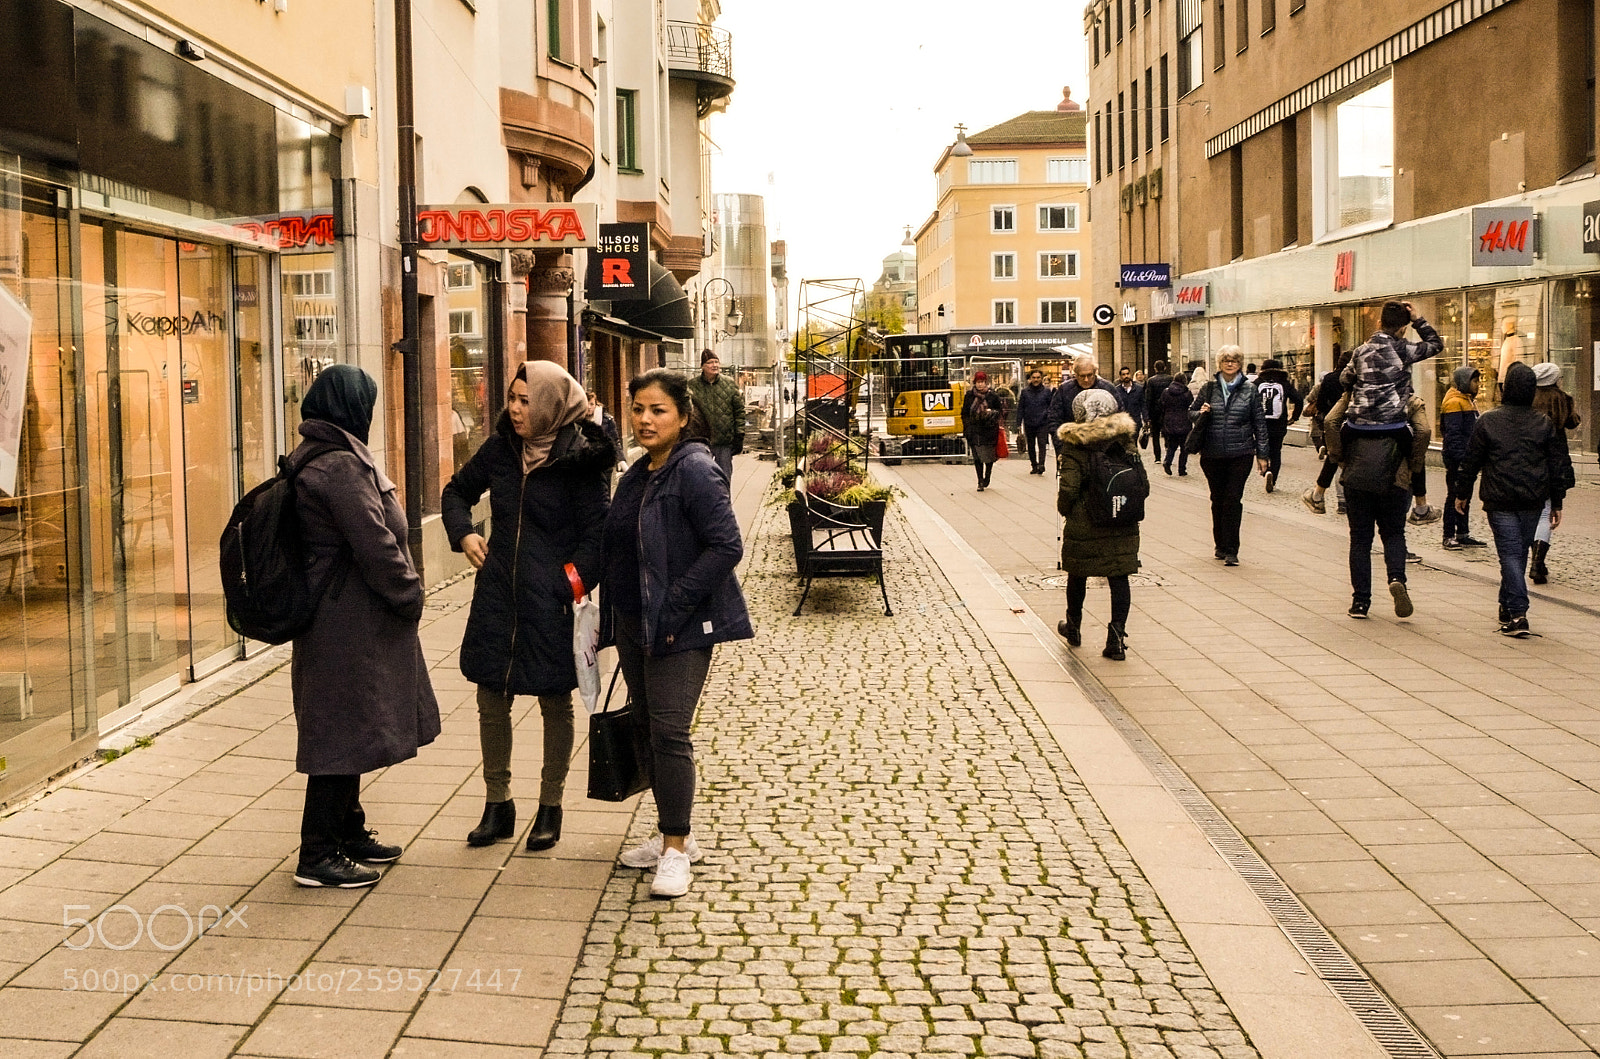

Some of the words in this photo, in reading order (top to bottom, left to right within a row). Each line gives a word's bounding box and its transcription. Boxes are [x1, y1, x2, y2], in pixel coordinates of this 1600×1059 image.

[418, 209, 585, 242] INDISKA
[598, 235, 639, 245] NILSON
[1480, 219, 1529, 253] H&M
[596, 244, 640, 253] SHOES
[602, 258, 634, 284] R
[1176, 286, 1204, 304] H&M
[924, 392, 951, 411] CAT
